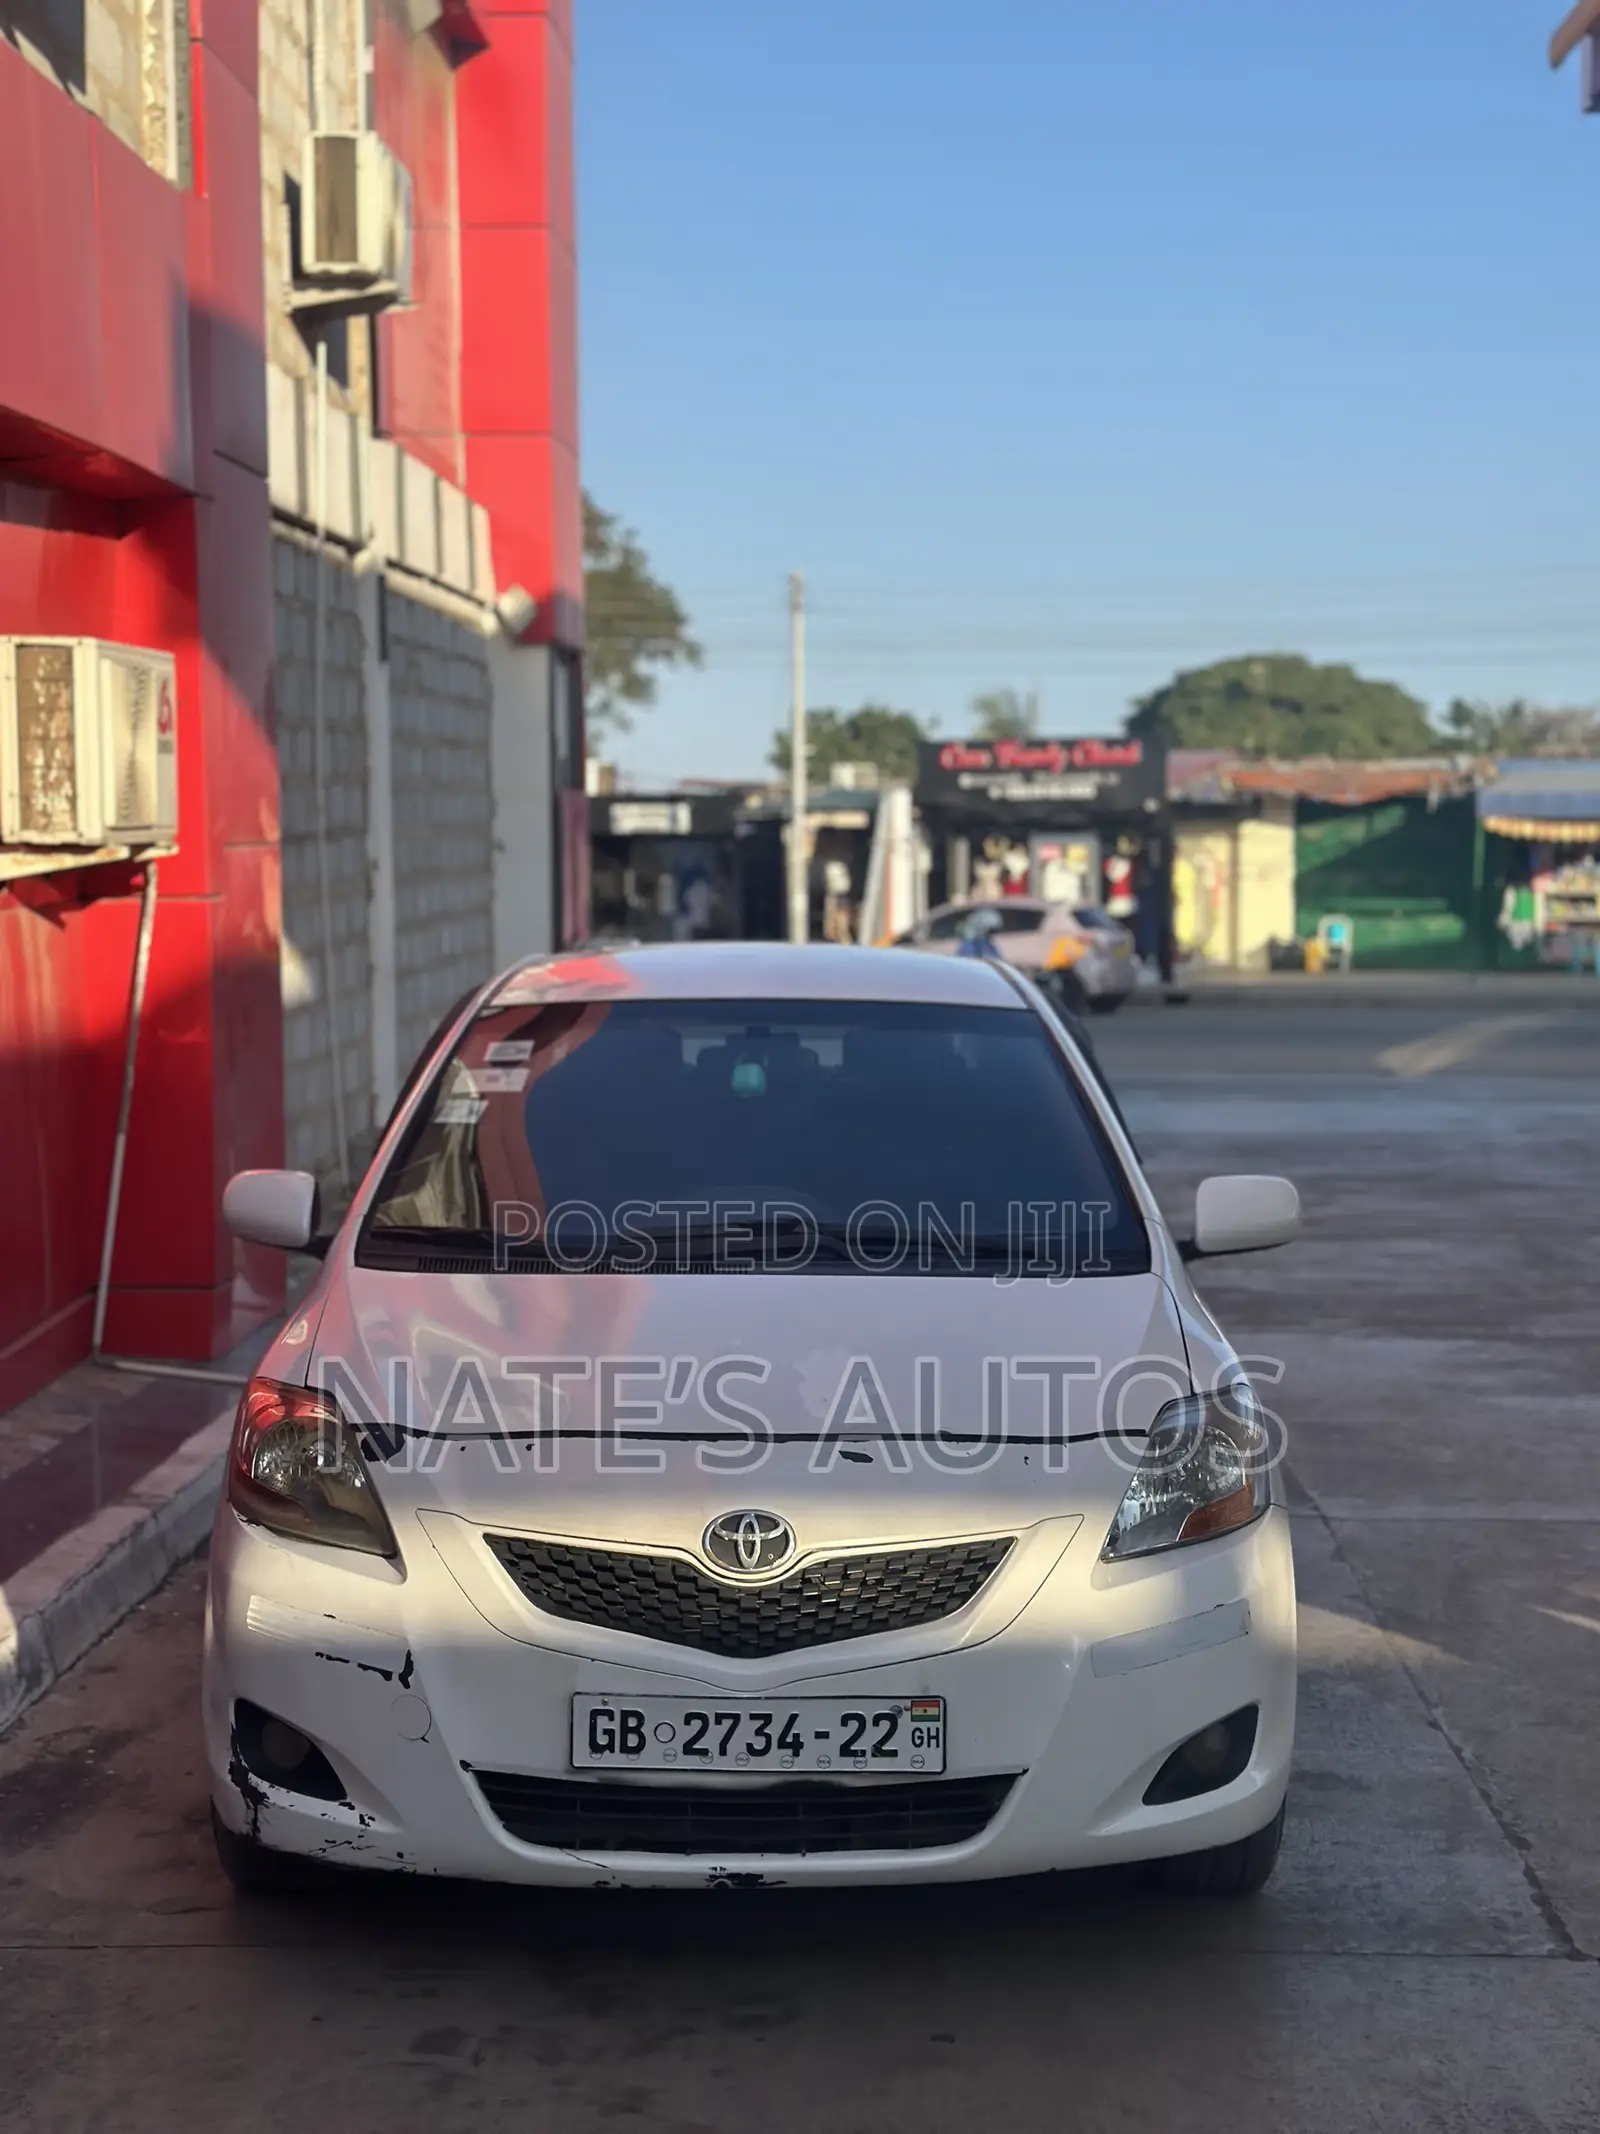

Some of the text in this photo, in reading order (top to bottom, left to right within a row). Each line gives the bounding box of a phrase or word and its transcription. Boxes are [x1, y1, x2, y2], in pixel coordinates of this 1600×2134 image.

[588, 1708, 899, 1758] GB 2734-22
[911, 1727, 940, 1748] GH
